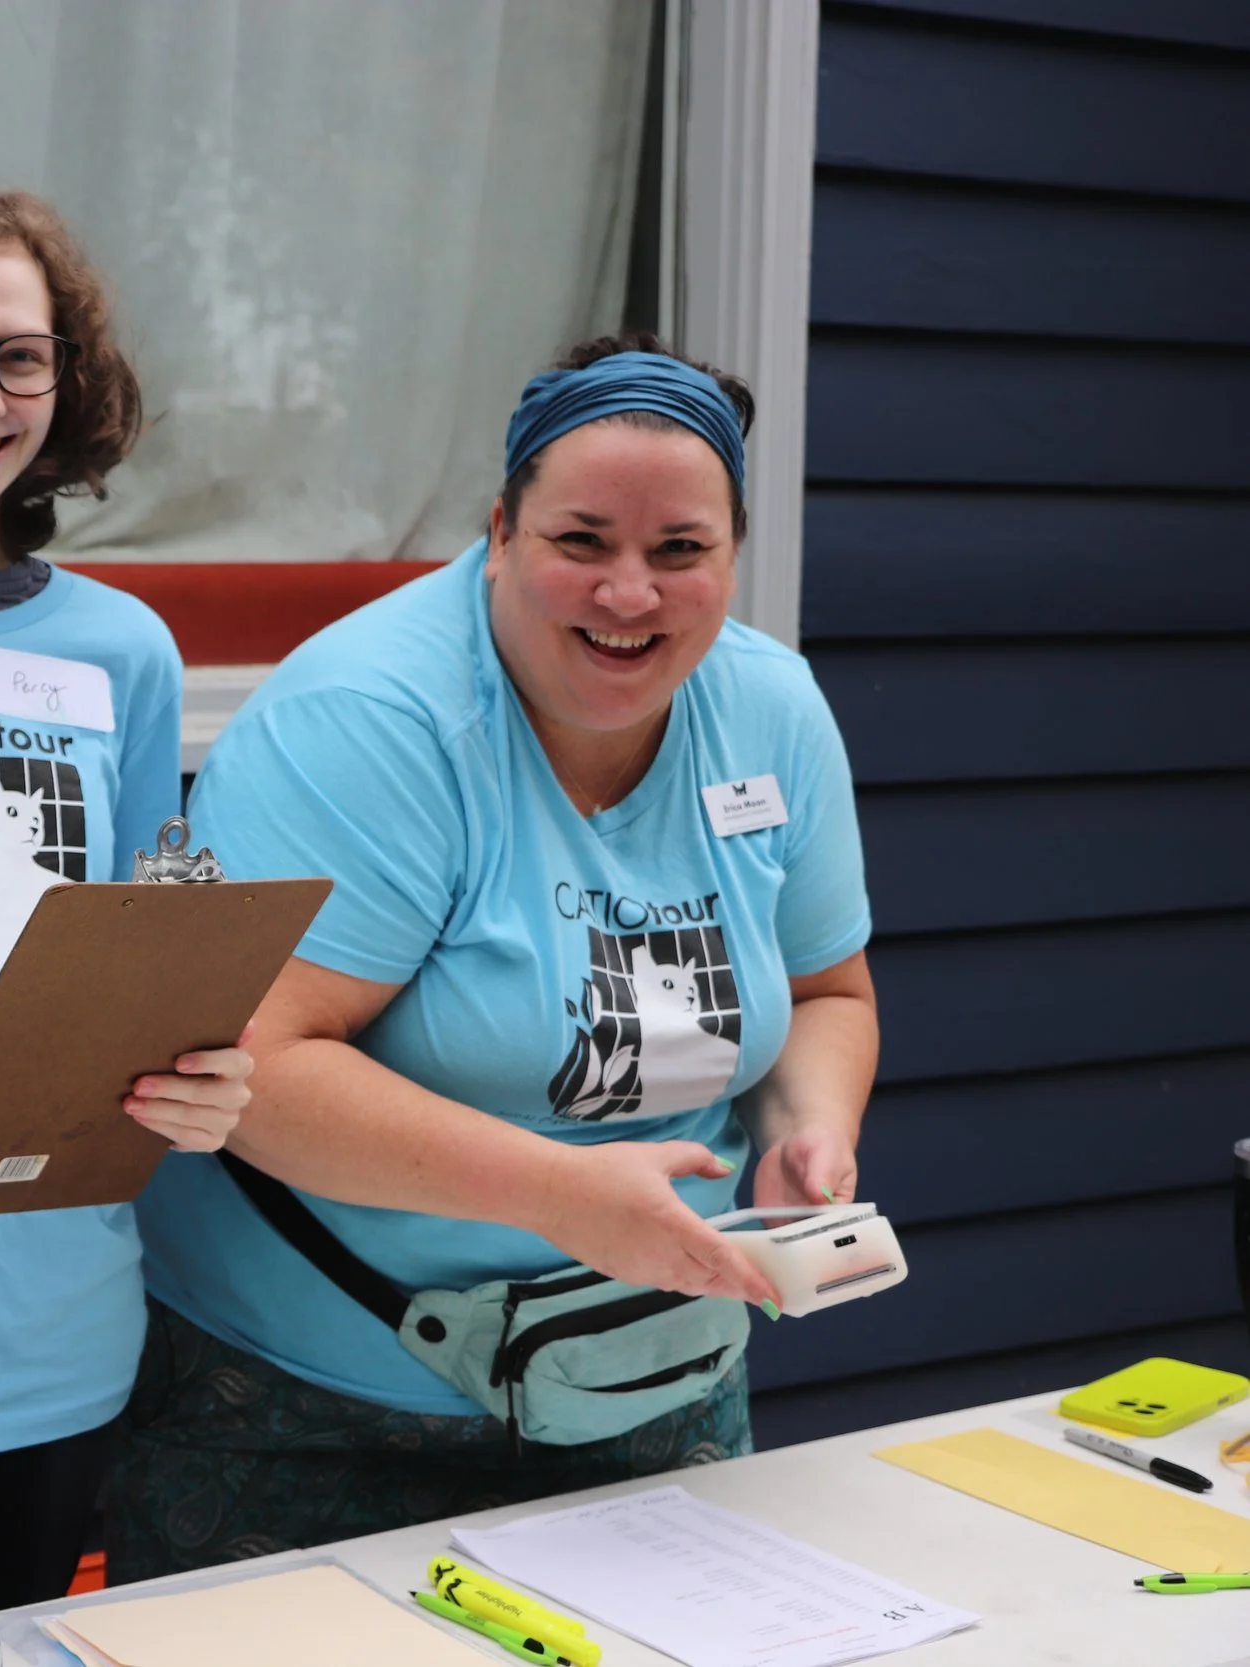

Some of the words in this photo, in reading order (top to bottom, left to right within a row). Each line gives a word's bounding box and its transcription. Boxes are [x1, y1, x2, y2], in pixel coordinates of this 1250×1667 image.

[13, 670, 68, 712] Percy
[555, 881, 719, 930] CATIOtour
[475, 1589, 523, 1617] highlighter
